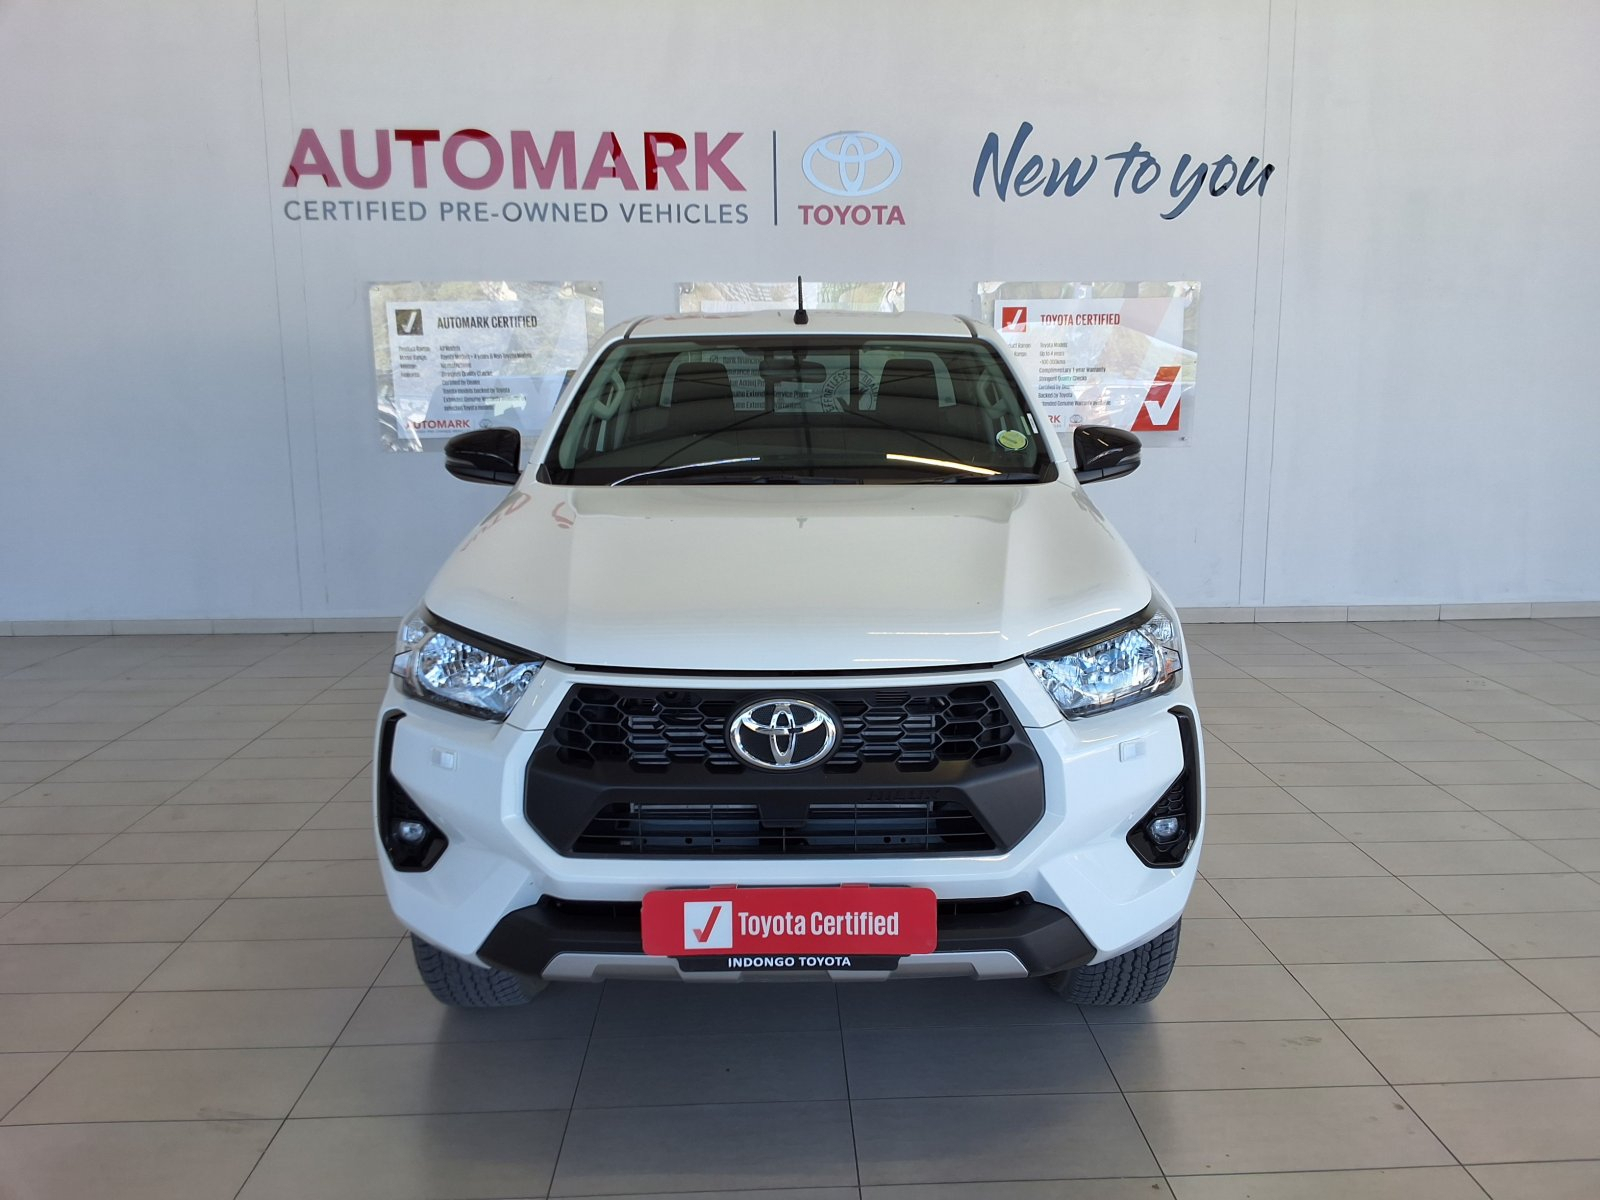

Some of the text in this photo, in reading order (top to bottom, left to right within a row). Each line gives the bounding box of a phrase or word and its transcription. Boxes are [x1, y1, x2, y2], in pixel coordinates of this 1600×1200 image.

[282, 128, 747, 191] AUTOMARK
[972, 121, 1275, 220] New to you
[284, 201, 749, 224] CERTIFIED PRE-OWNED VEHICLES
[798, 205, 906, 226] TOYOTA
[437, 315, 538, 329] AUTOMARK CERTIFIED
[1040, 313, 1120, 326] TOYOTA CERTIFIED
[409, 419, 471, 430] UTOMARK
[737, 911, 899, 938] Toyota Certified
[728, 956, 851, 968] INDONGO TOYOTA
